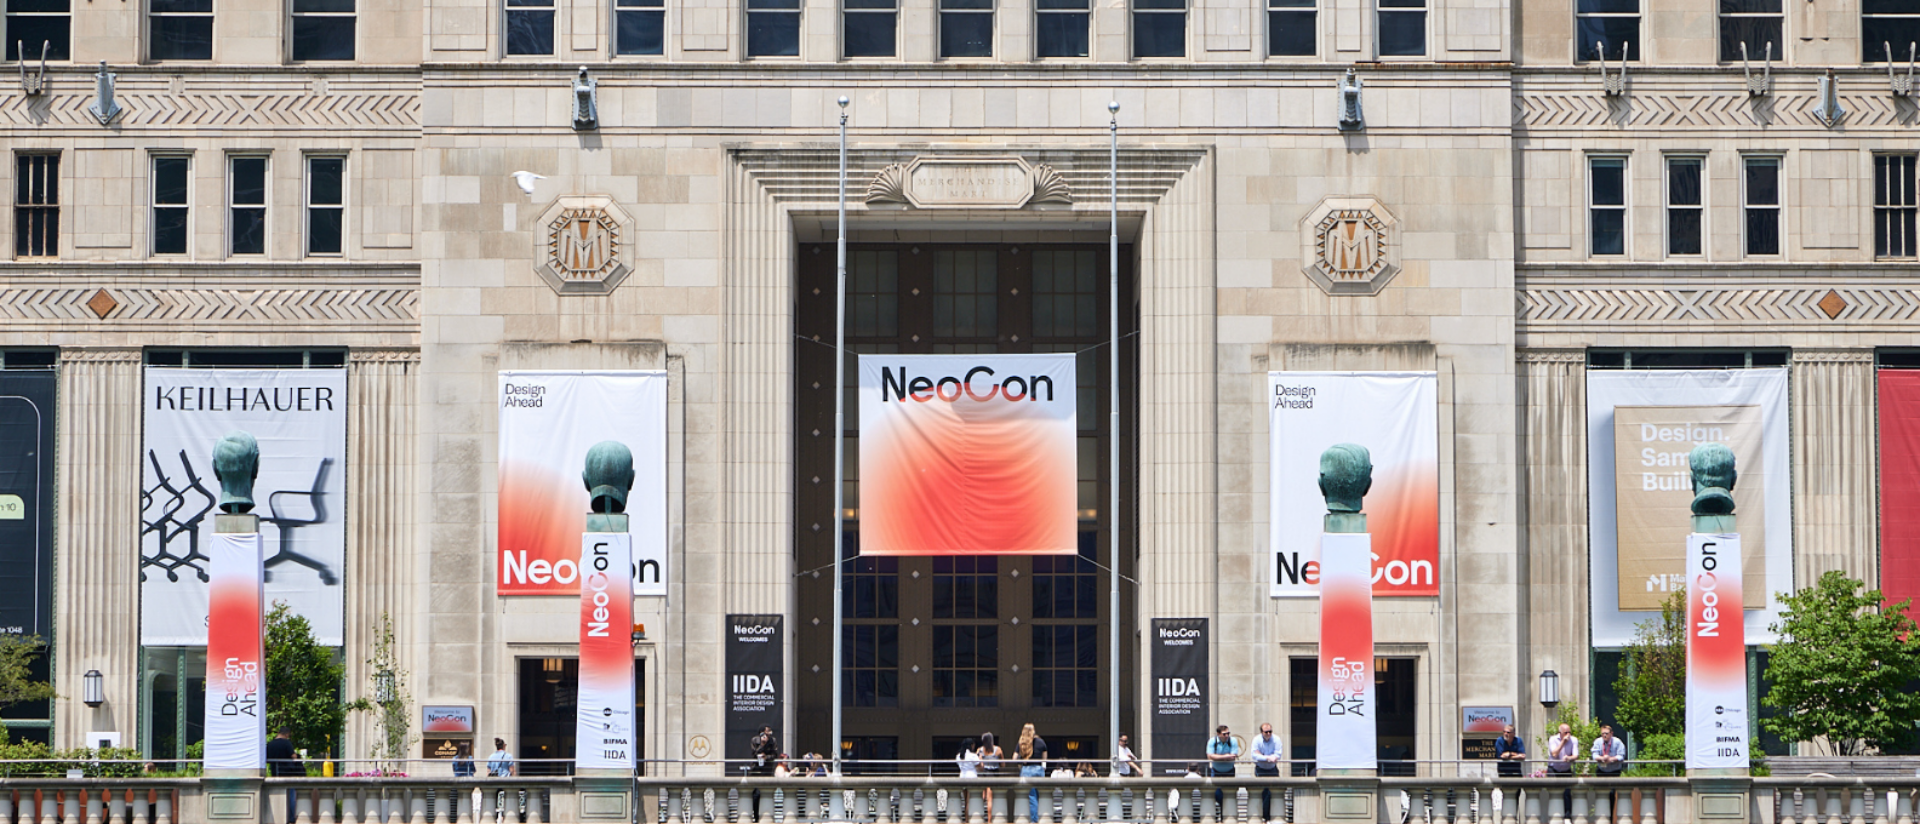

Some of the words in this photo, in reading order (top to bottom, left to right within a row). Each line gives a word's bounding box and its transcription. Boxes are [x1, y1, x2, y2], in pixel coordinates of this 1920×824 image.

[918, 178, 1020, 186] MERCHANDISE
[505, 383, 546, 397] Design
[881, 365, 1053, 402] NeoCon
[1275, 384, 1316, 398] Design
[156, 386, 333, 411] KEILHAUER
[504, 396, 543, 408] Ahead
[1274, 397, 1313, 409] Ahead
[1641, 423, 1730, 445] Design.
[587, 542, 609, 637] NeoCon
[1697, 542, 1719, 637] NeoCon
[7, 626, 23, 634] 1048
[734, 624, 775, 635] NeoCon
[1159, 628, 1201, 638] NeoCon
[221, 657, 243, 716] Design
[239, 661, 257, 717] Ahead
[733, 674, 775, 693] IIDA
[1158, 678, 1201, 697] IIDA
[1329, 656, 1350, 715] Design
[1346, 661, 1365, 717] Ahead
[428, 714, 467, 722] NeoCon
[1468, 714, 1507, 722] NeoCon
[604, 749, 626, 759] IIDA
[1717, 748, 1740, 757] IIDA
